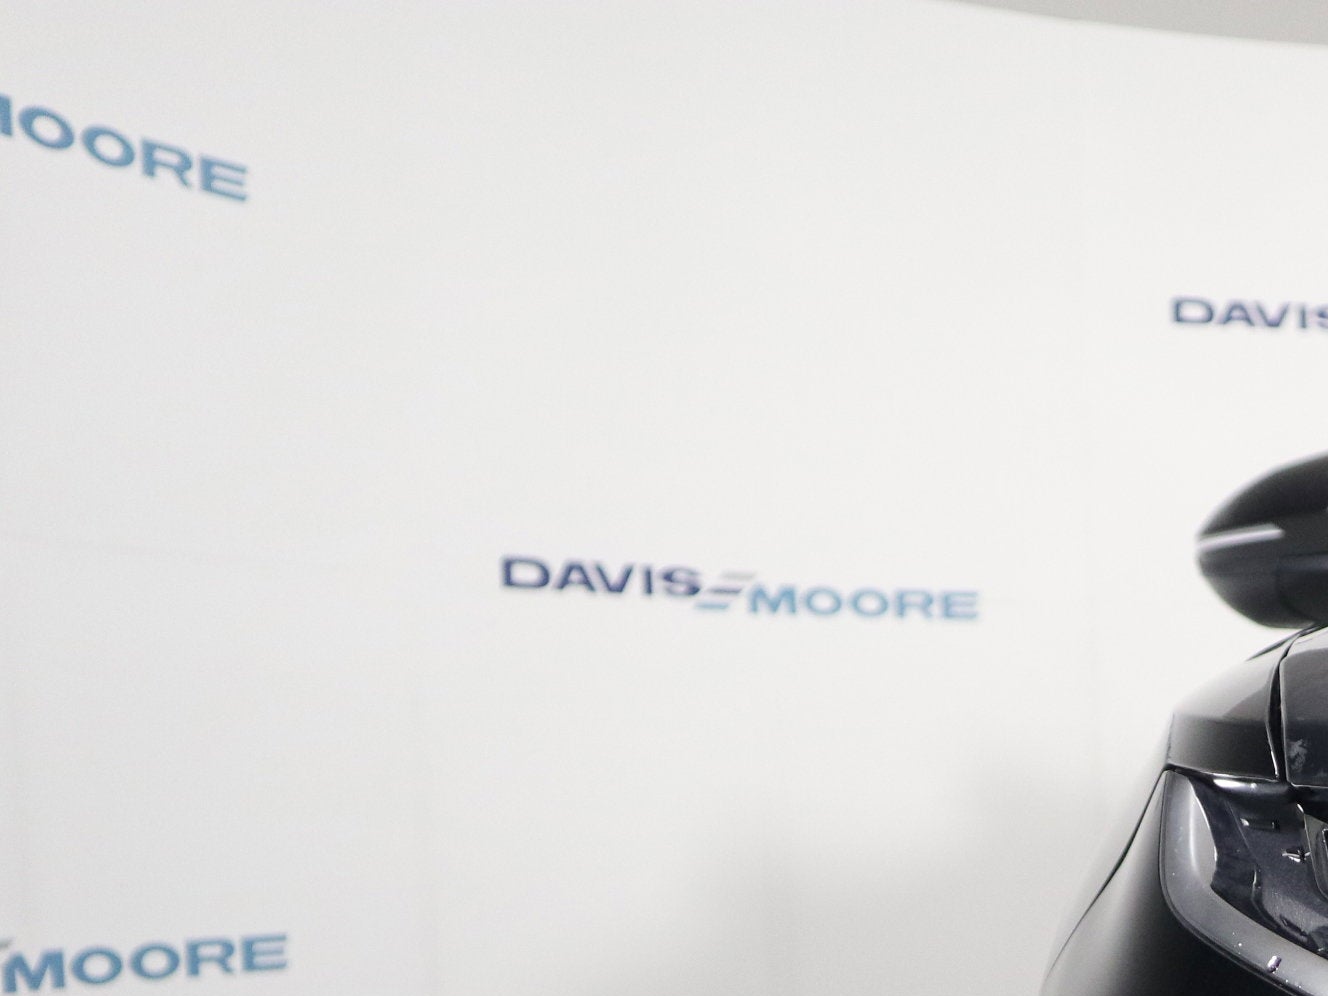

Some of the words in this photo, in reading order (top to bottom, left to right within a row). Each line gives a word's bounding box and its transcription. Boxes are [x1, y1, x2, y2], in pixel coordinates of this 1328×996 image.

[0, 93, 249, 202] OORE
[501, 556, 702, 598] DAVIS
[748, 584, 980, 621] MOORE
[1, 933, 288, 994] MOORE
